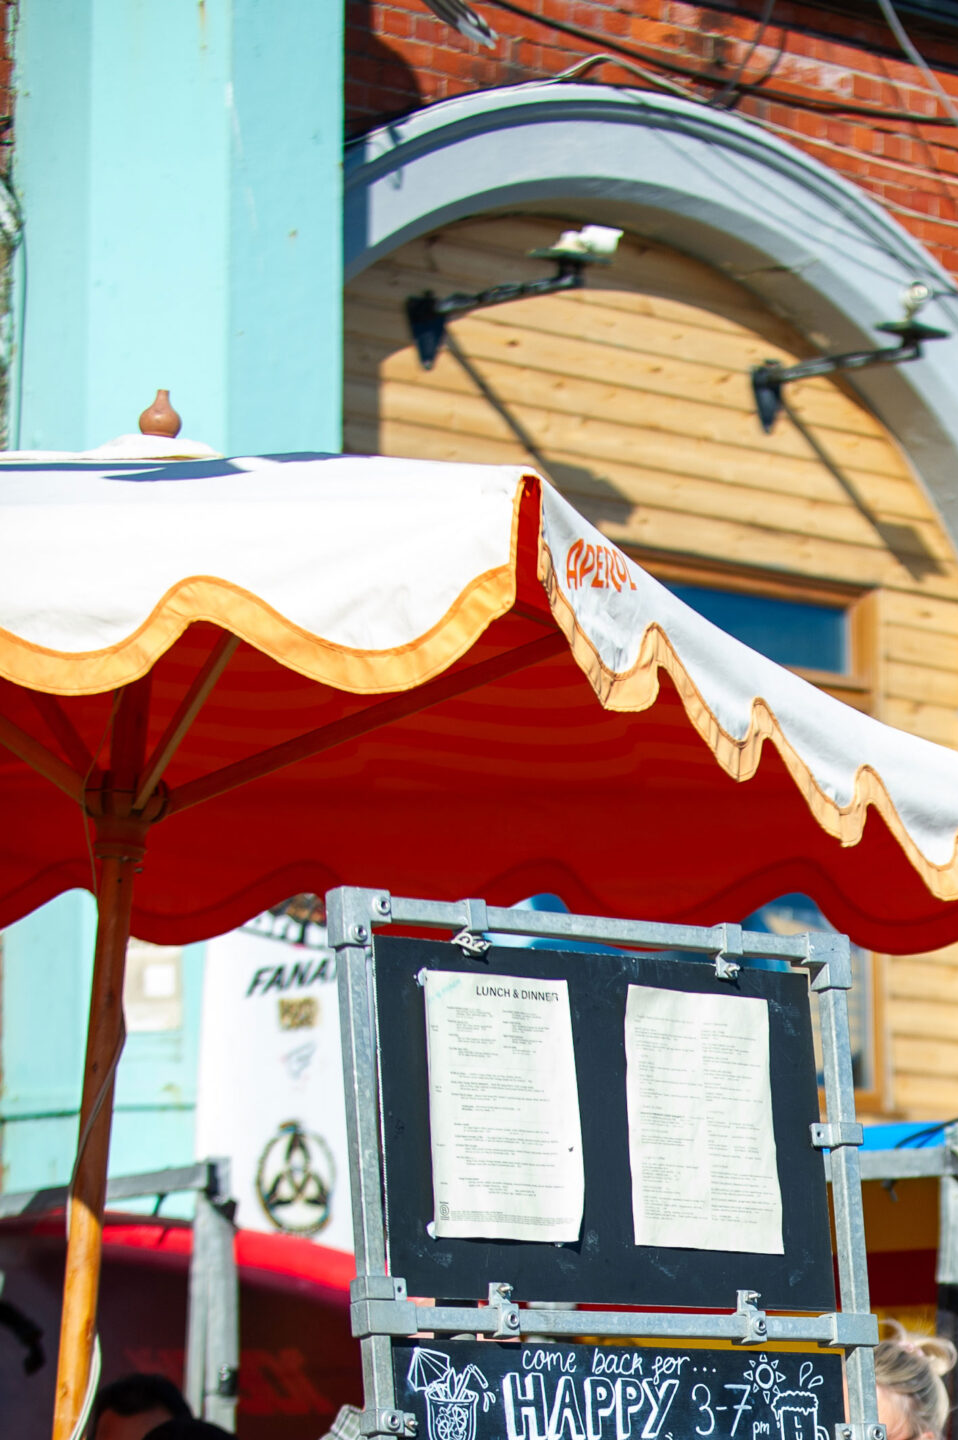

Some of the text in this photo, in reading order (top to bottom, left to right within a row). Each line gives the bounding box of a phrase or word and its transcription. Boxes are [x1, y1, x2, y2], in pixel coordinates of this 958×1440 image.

[566, 538, 637, 593] APEROL
[246, 957, 336, 997] FANA
[476, 985, 559, 1001] LUNCH & DINNER
[522, 1349, 577, 1373] come
[591, 1347, 643, 1376] back
